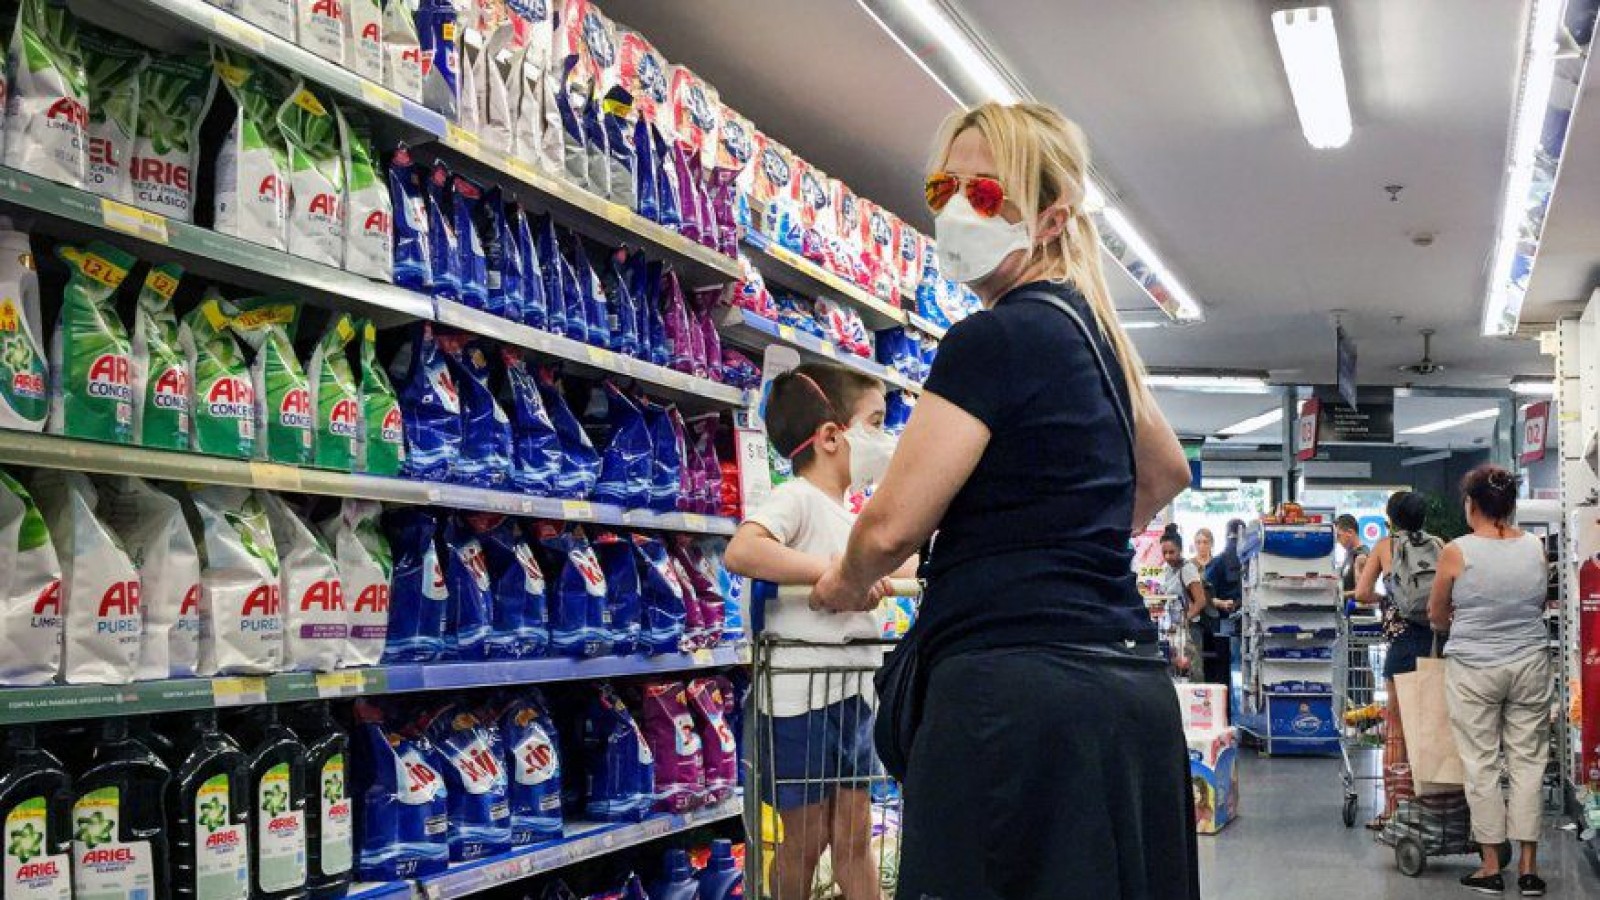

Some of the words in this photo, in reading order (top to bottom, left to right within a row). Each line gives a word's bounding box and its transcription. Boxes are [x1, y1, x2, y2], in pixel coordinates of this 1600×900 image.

[139, 191, 187, 210] CLASICO
[1527, 423, 1541, 444] 02
[206, 830, 240, 846] ARIEL
[82, 848, 136, 864] ARIEL
[16, 861, 59, 879] ARIEL
